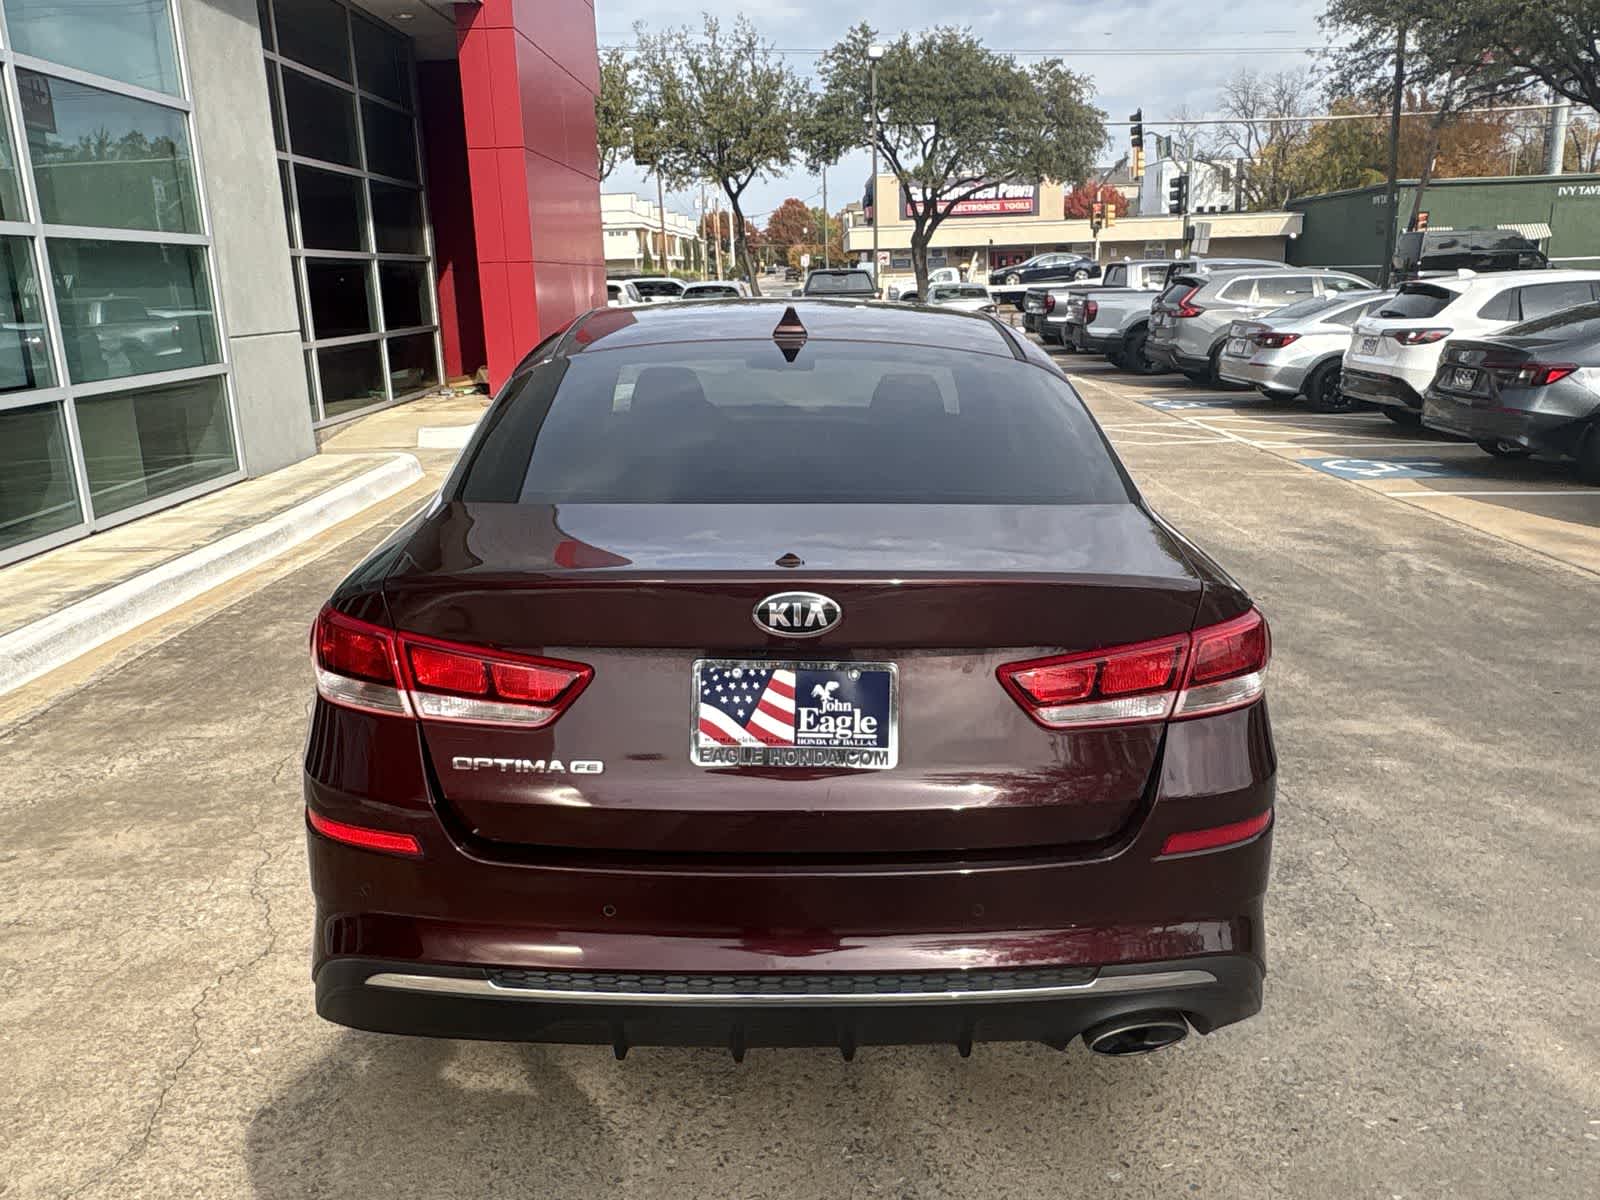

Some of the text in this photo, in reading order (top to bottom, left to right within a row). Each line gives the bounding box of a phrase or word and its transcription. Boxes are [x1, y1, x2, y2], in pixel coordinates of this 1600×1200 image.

[998, 183, 1034, 199] Pawn
[1558, 186, 1577, 196] IVY
[1004, 201, 1030, 210] TOOLS
[768, 602, 828, 627] KIA
[819, 699, 852, 714] John
[798, 708, 878, 739] Eagle
[700, 748, 764, 765] EAGLE
[452, 757, 566, 773] OPTIMA
